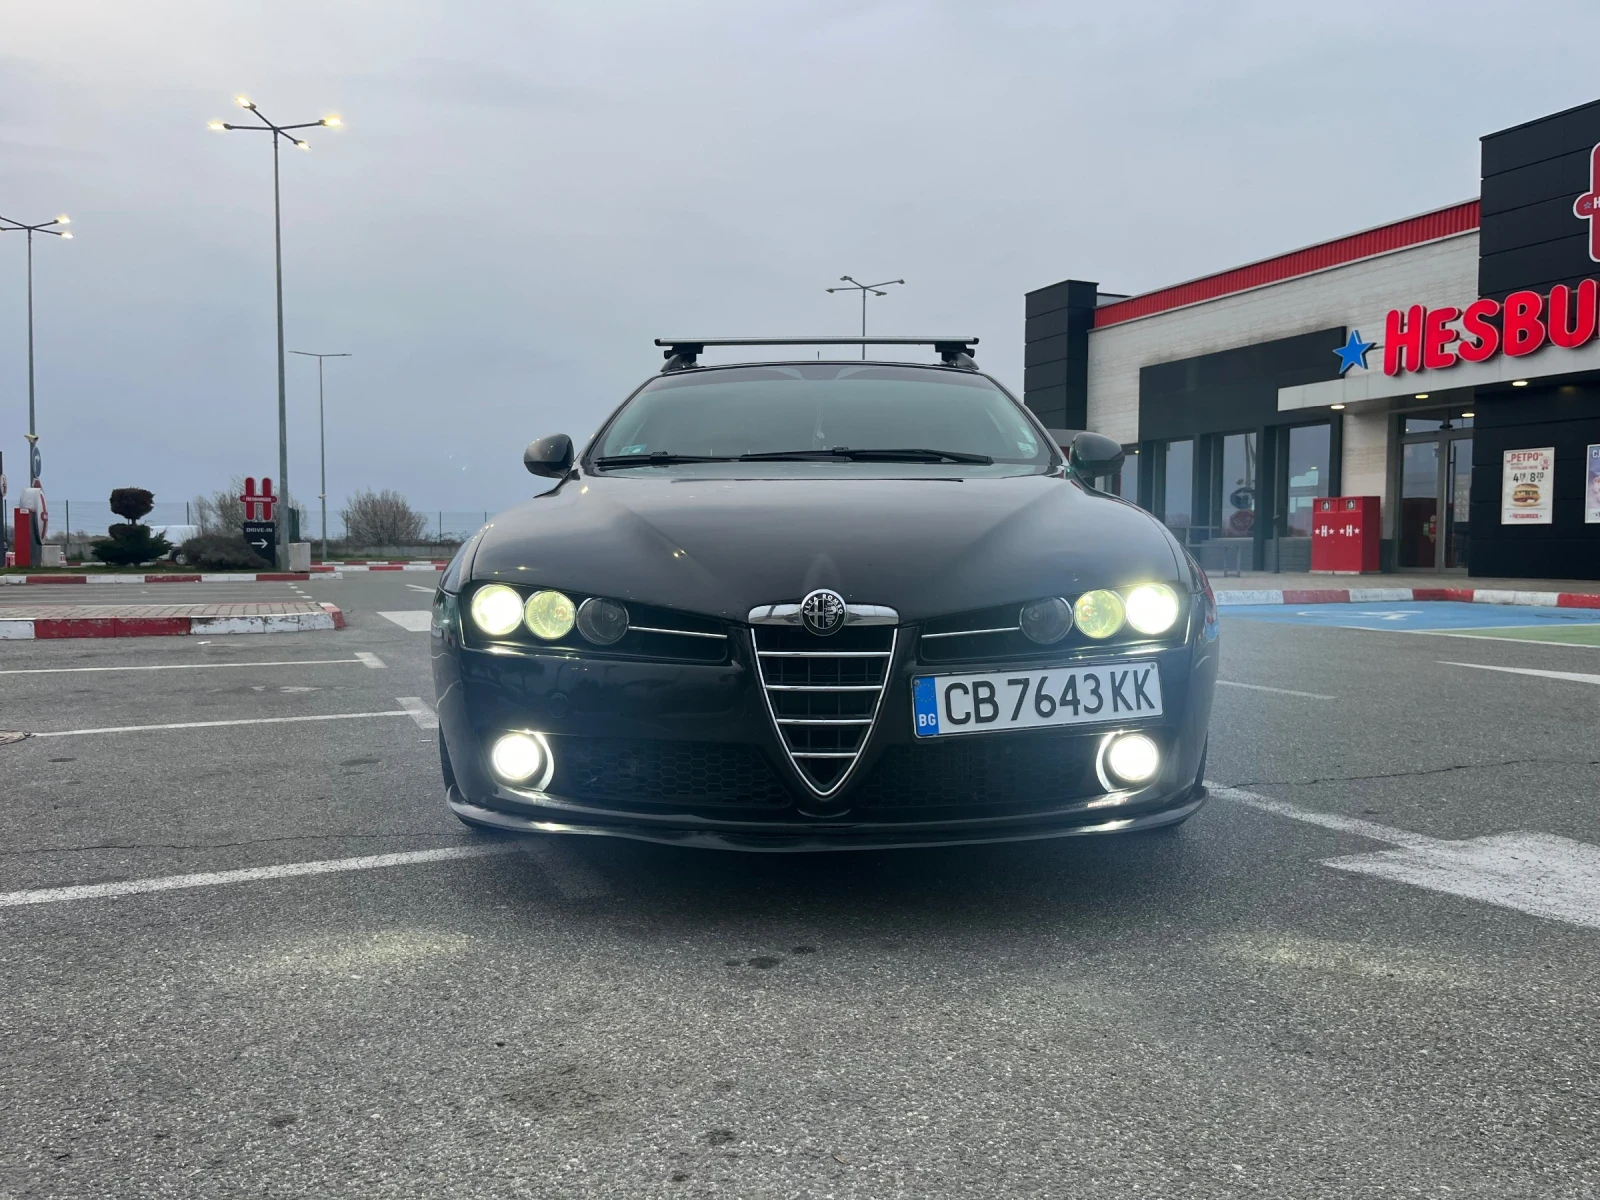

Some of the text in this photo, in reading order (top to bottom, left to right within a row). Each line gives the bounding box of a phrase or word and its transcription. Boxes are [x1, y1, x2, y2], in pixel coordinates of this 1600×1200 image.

[1384, 279, 1600, 376] HESBU
[918, 713, 937, 727] BG
[944, 669, 1156, 726] CB 7643 KK
